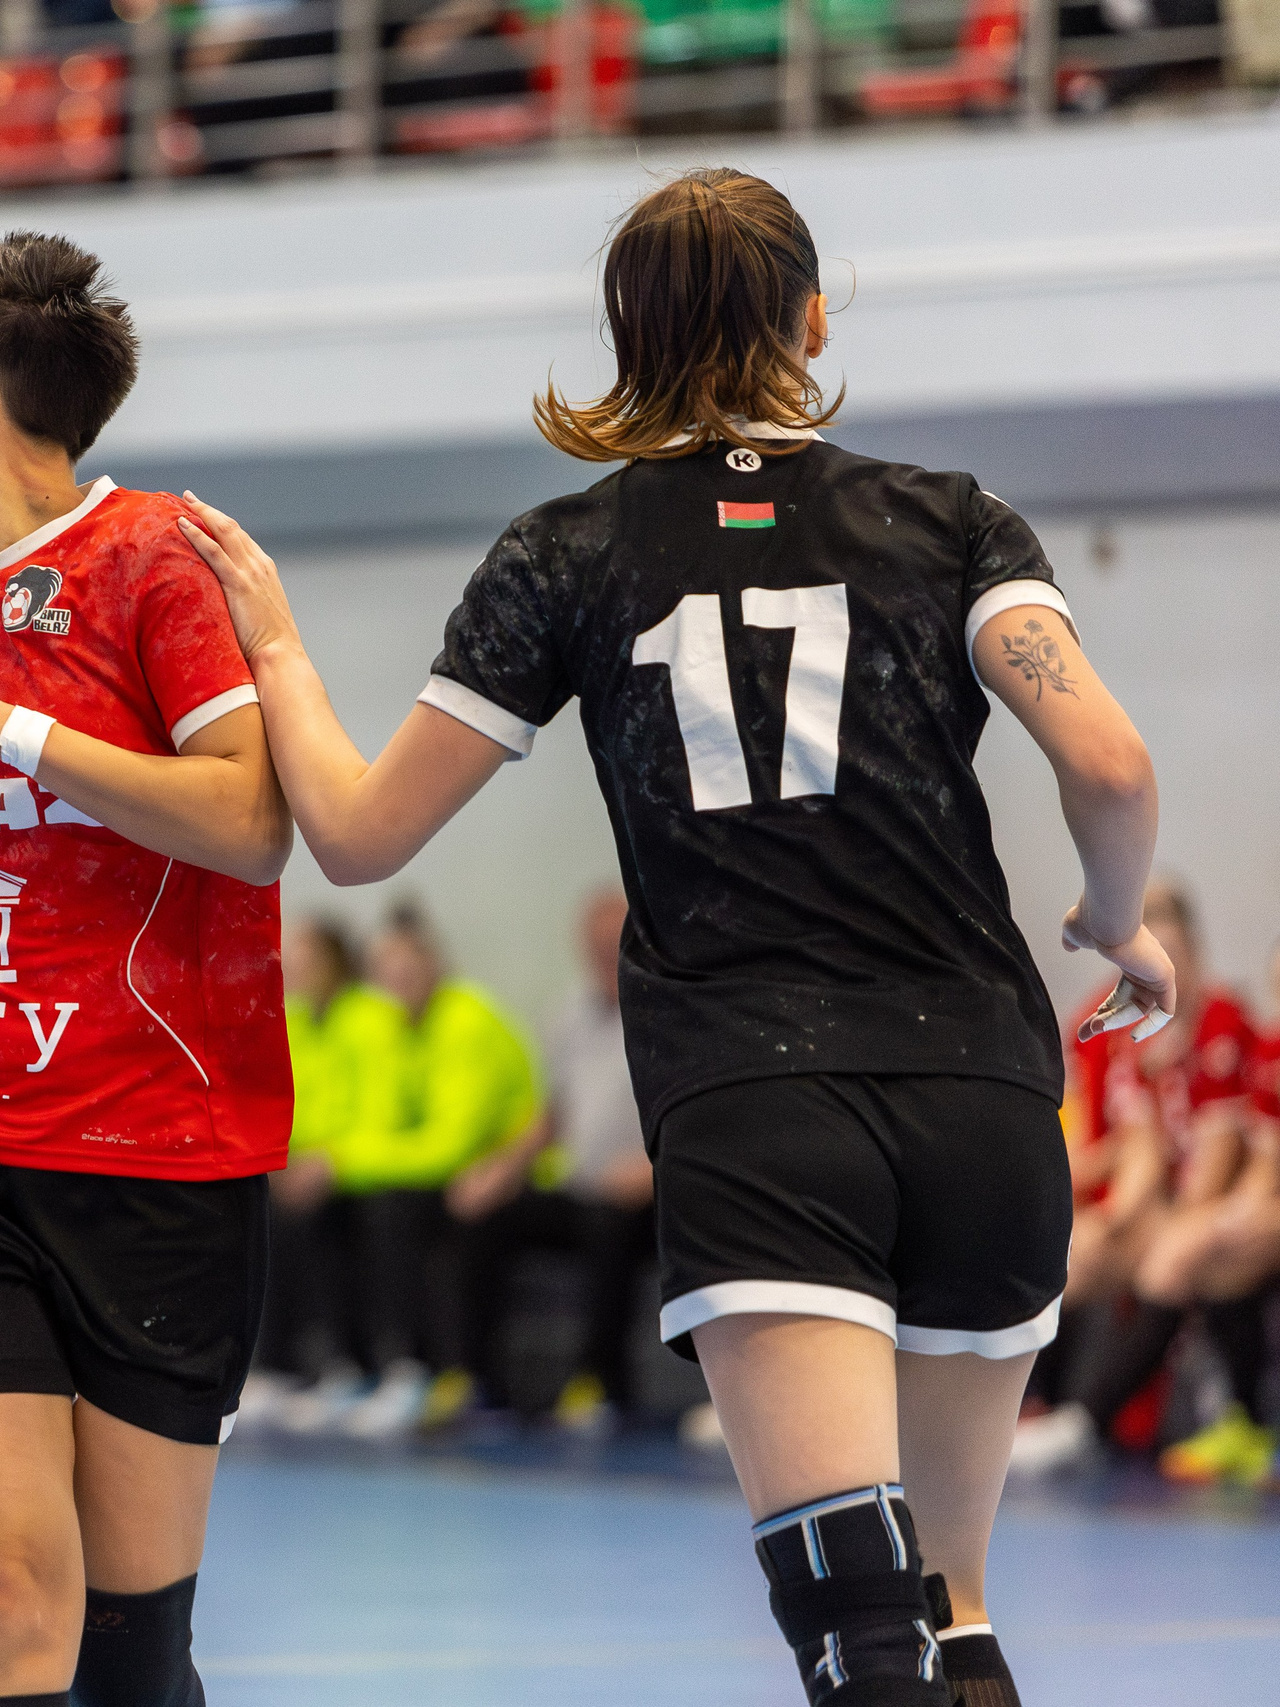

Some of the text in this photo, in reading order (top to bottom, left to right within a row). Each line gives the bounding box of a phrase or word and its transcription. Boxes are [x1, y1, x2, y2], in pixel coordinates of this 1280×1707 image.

[40, 610, 70, 622] BNTU
[34, 619, 68, 634] BELAZ
[632, 583, 850, 812] 17
